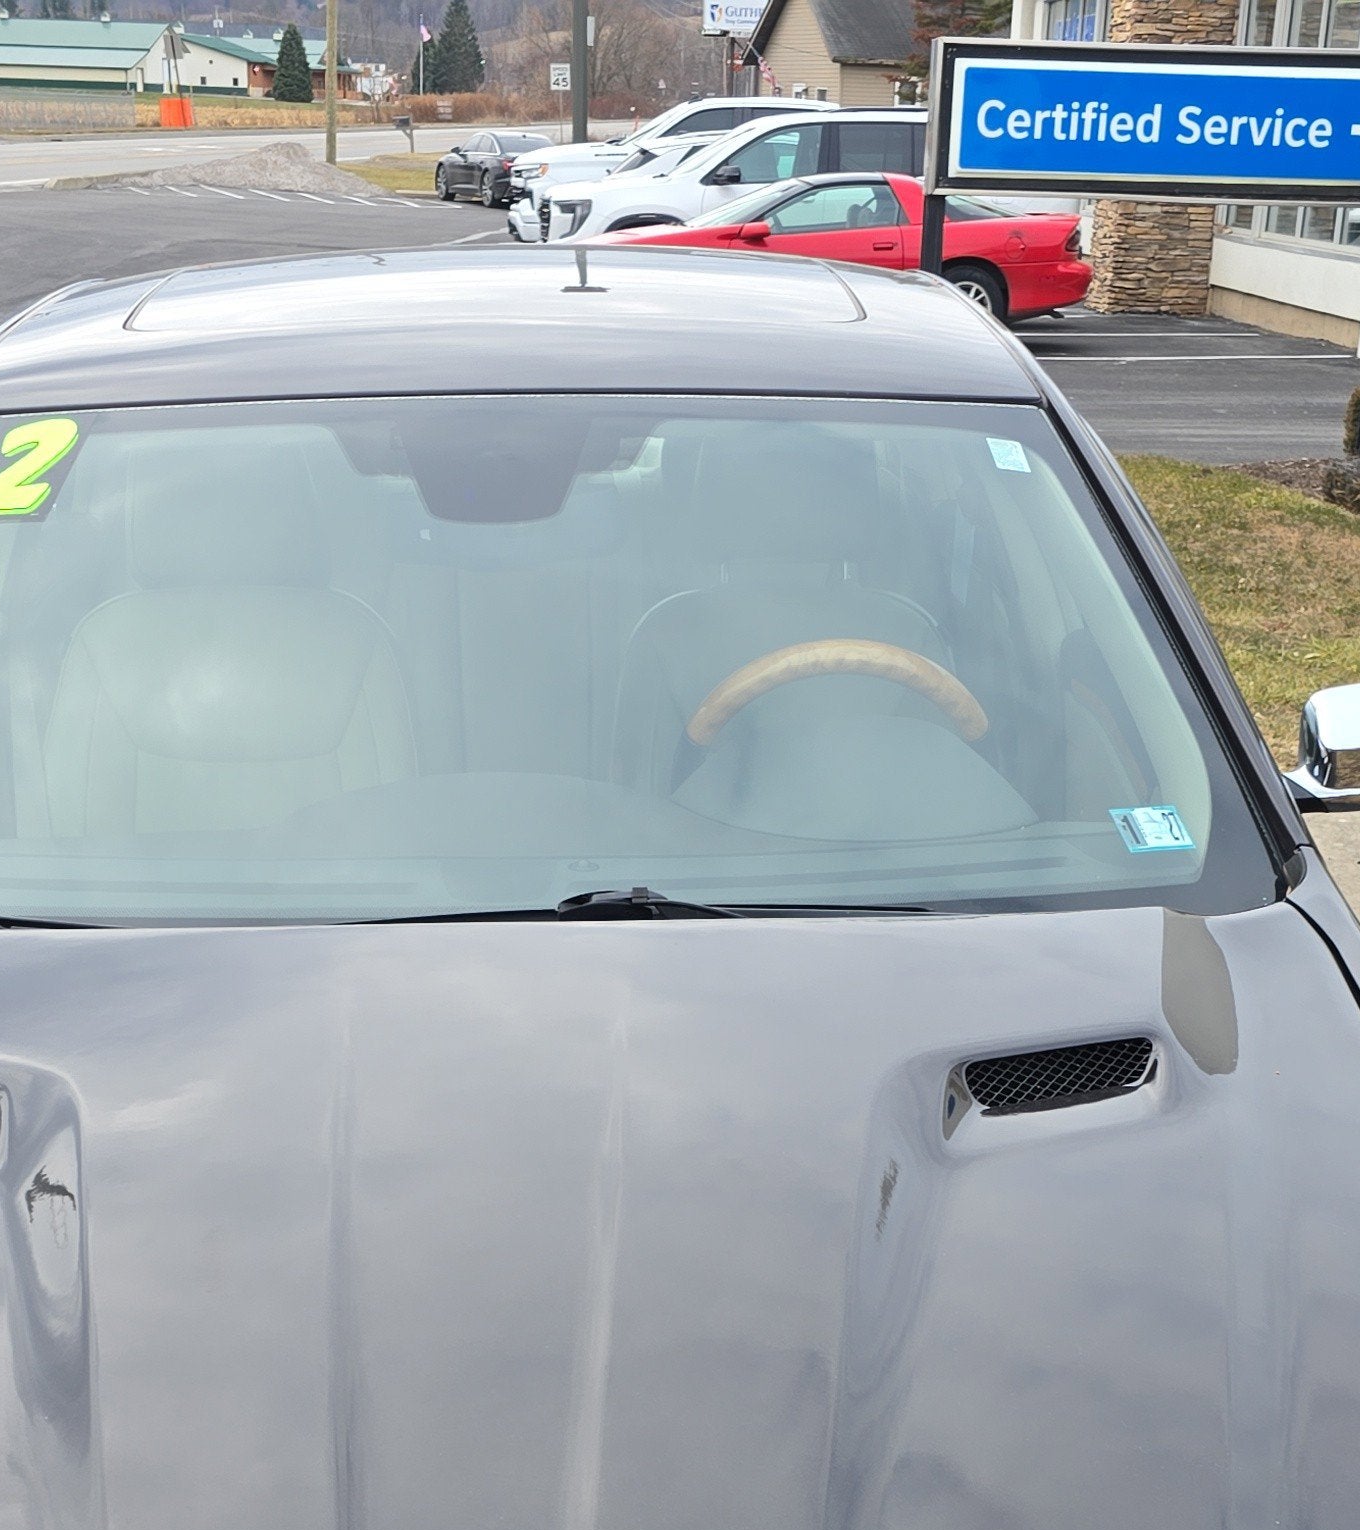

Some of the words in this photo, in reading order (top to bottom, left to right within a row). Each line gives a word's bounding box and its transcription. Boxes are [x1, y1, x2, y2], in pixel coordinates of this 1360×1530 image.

[552, 77, 569, 88] 45
[977, 99, 1163, 143] Certified
[1176, 104, 1333, 148] Service
